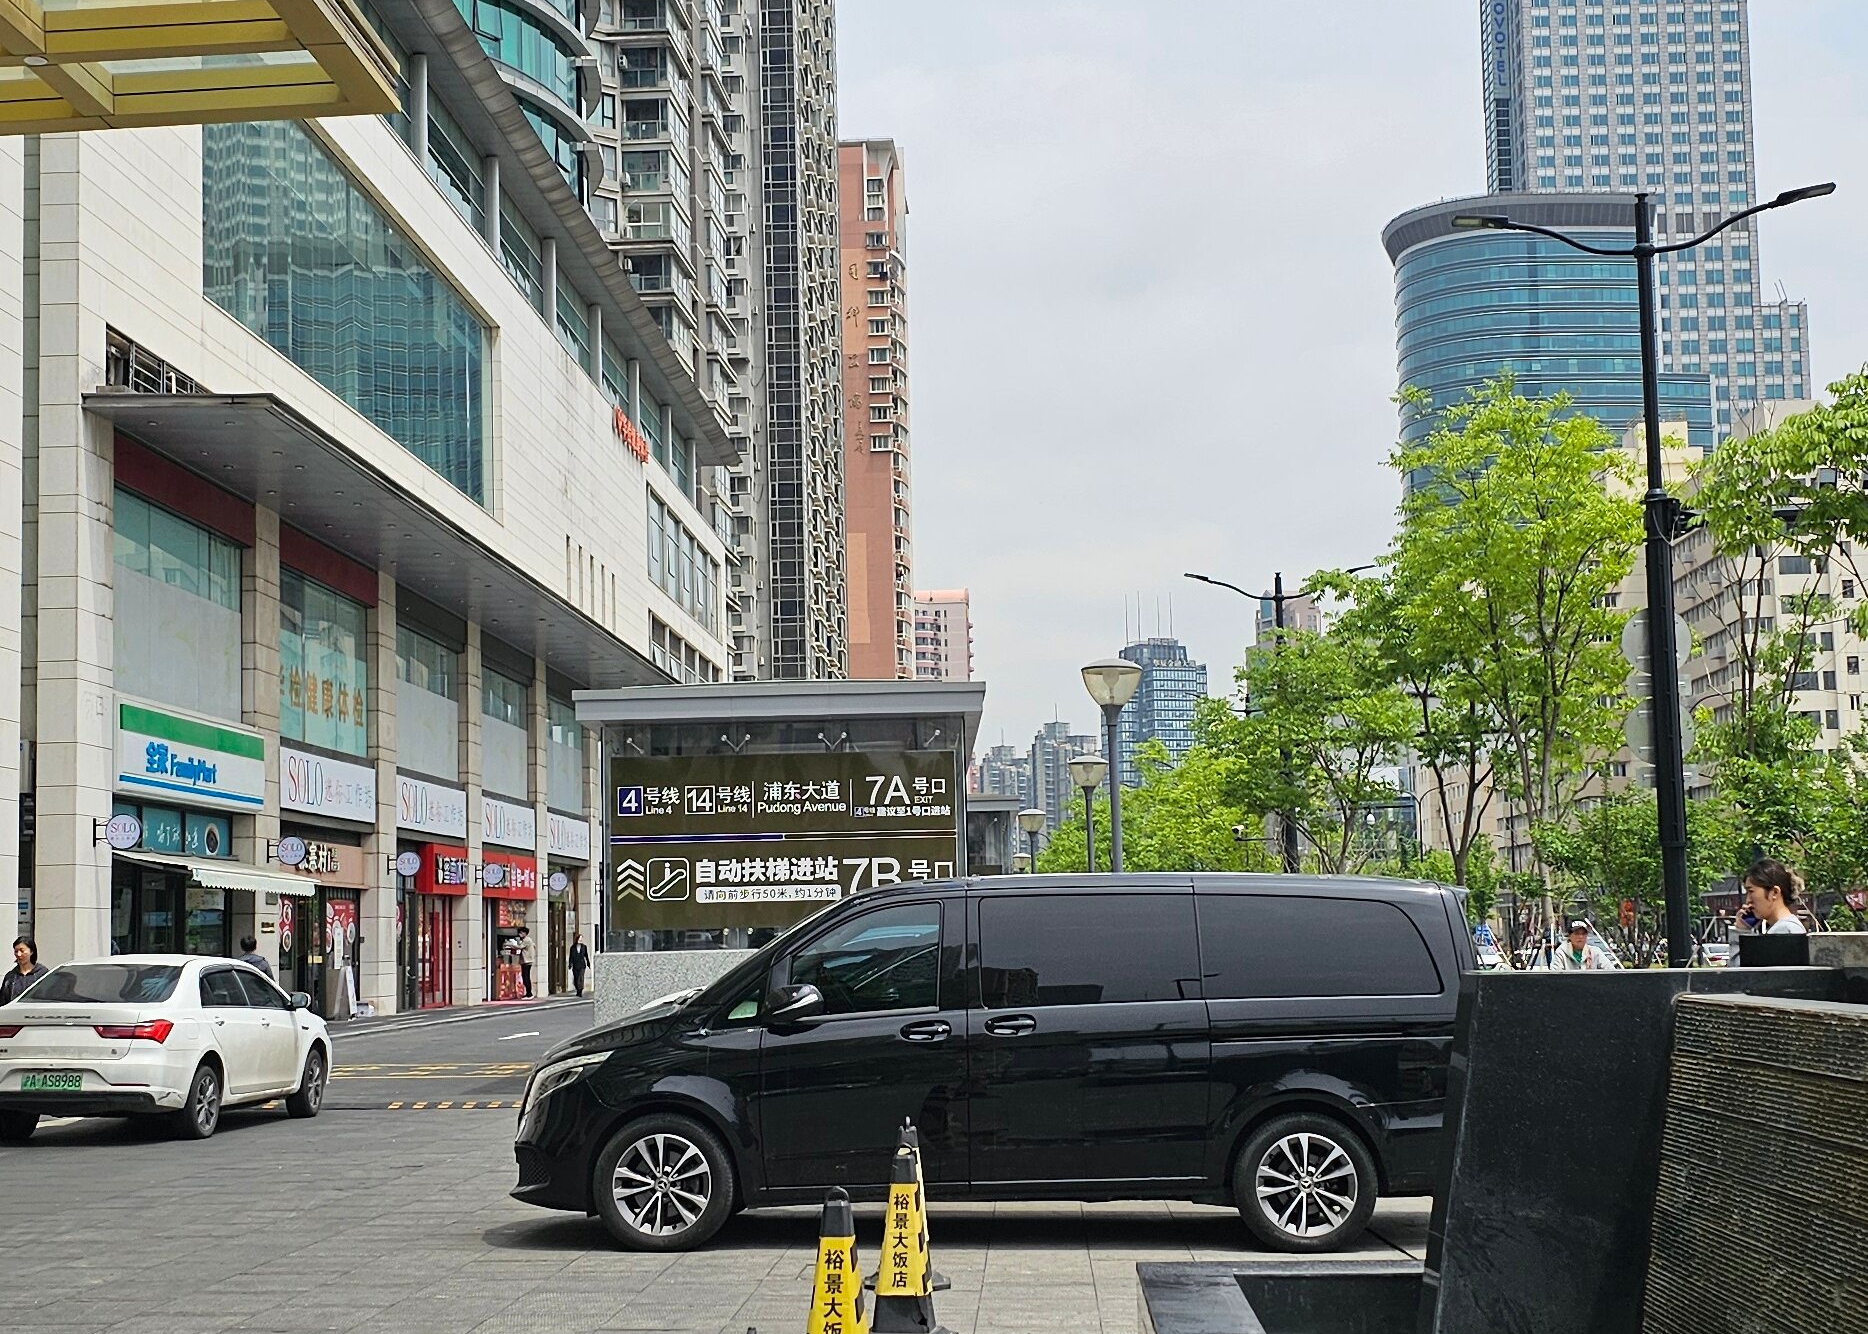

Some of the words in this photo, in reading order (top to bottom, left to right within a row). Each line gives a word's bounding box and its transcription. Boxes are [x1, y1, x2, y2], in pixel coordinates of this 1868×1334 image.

[146, 741, 168, 774] 全家
[170, 753, 217, 786] FamilyMart
[288, 755, 323, 807] SOLO
[763, 780, 841, 801] 浦东大道
[865, 775, 911, 805] 7A
[912, 776, 946, 794] 号口
[402, 782, 428, 825] SOLO
[622, 789, 639, 812] 4
[644, 786, 681, 805] 号线
[687, 788, 712, 812] 14
[716, 786, 752, 804] 号线
[645, 806, 664, 815] Line
[665, 805, 673, 815] 4
[718, 804, 736, 813] Line
[738, 803, 748, 813] 14
[757, 801, 801, 814] Pudong
[802, 800, 847, 813] Avenue
[914, 795, 933, 804] EXIT
[111, 822, 137, 833] SOLO
[485, 802, 505, 840] SOLO
[281, 843, 302, 852] SOLO
[695, 856, 839, 884] 自动扶梯进站
[42, 1074, 81, 1088] AS8988
[891, 1193, 910, 1288] 裕景大饭店
